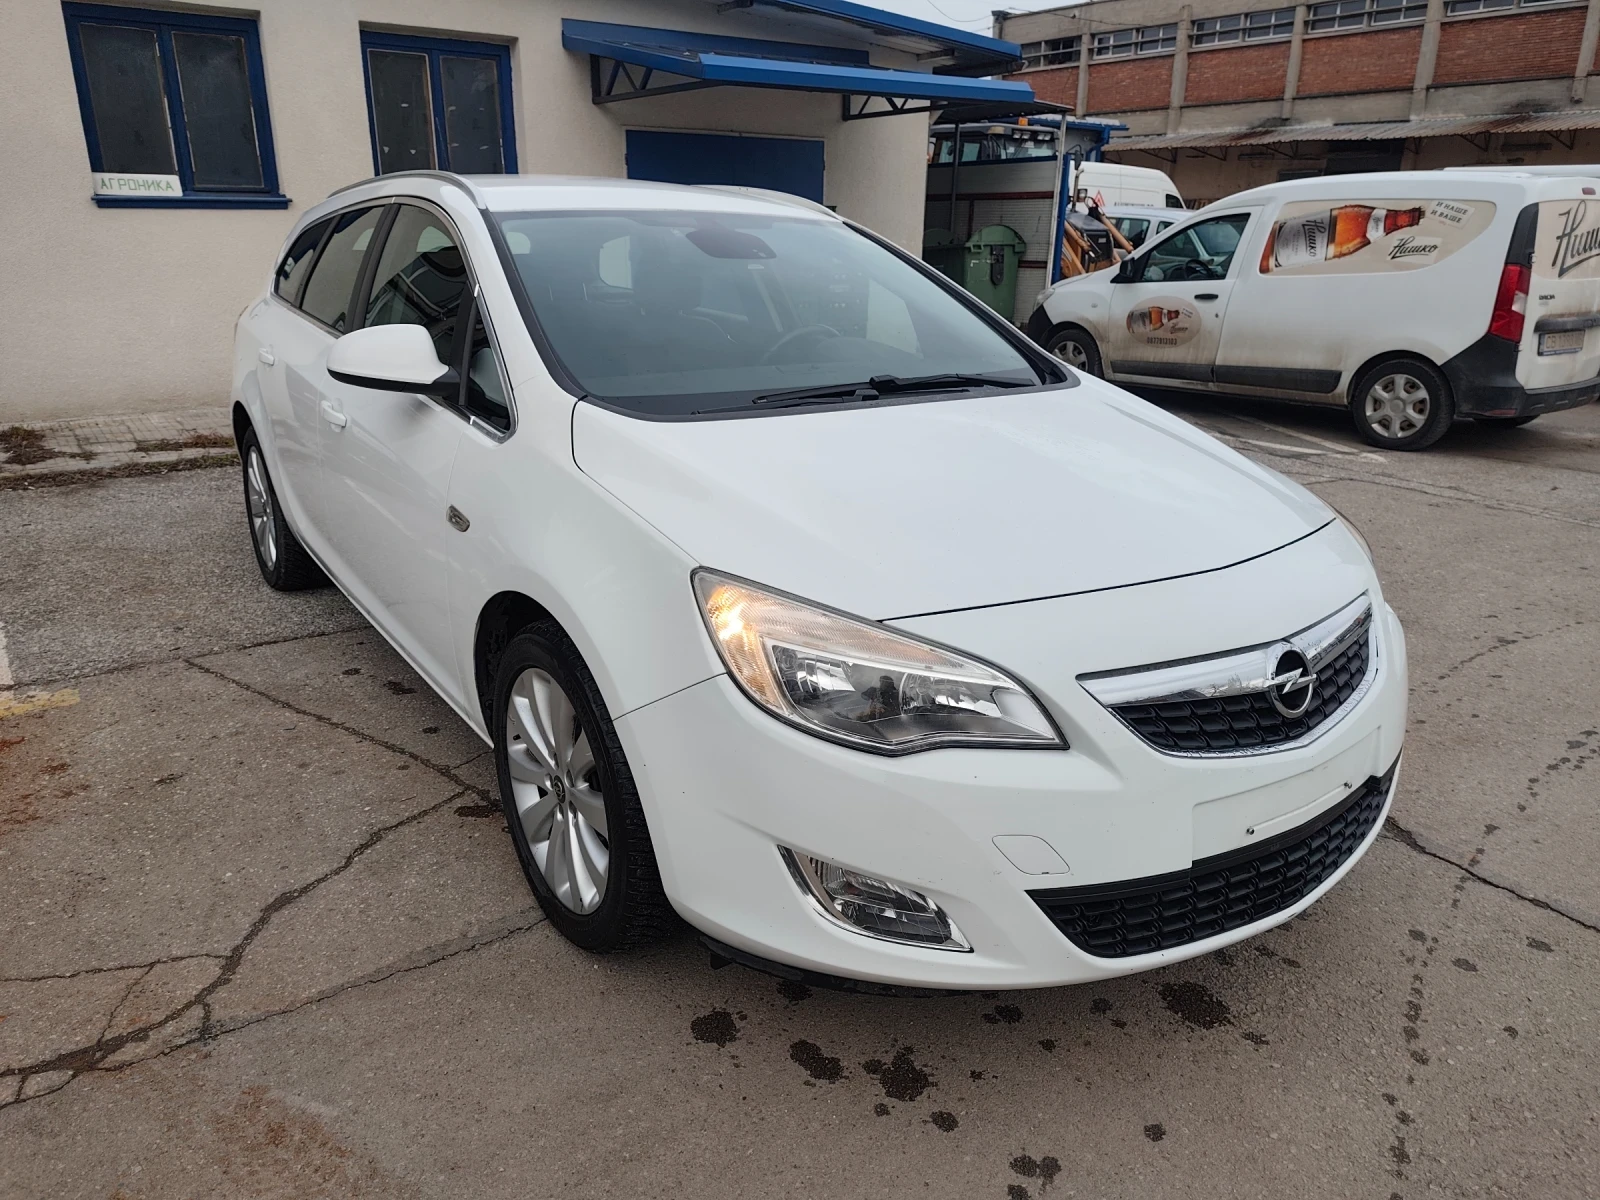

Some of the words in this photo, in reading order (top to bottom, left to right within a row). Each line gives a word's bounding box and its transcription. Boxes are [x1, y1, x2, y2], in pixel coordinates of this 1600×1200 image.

[101, 177, 175, 192] АГРОНИКА
[1444, 203, 1469, 216] НАШЕ
[1438, 212, 1463, 224] ВАШЕ
[1388, 236, 1439, 260] Нишко
